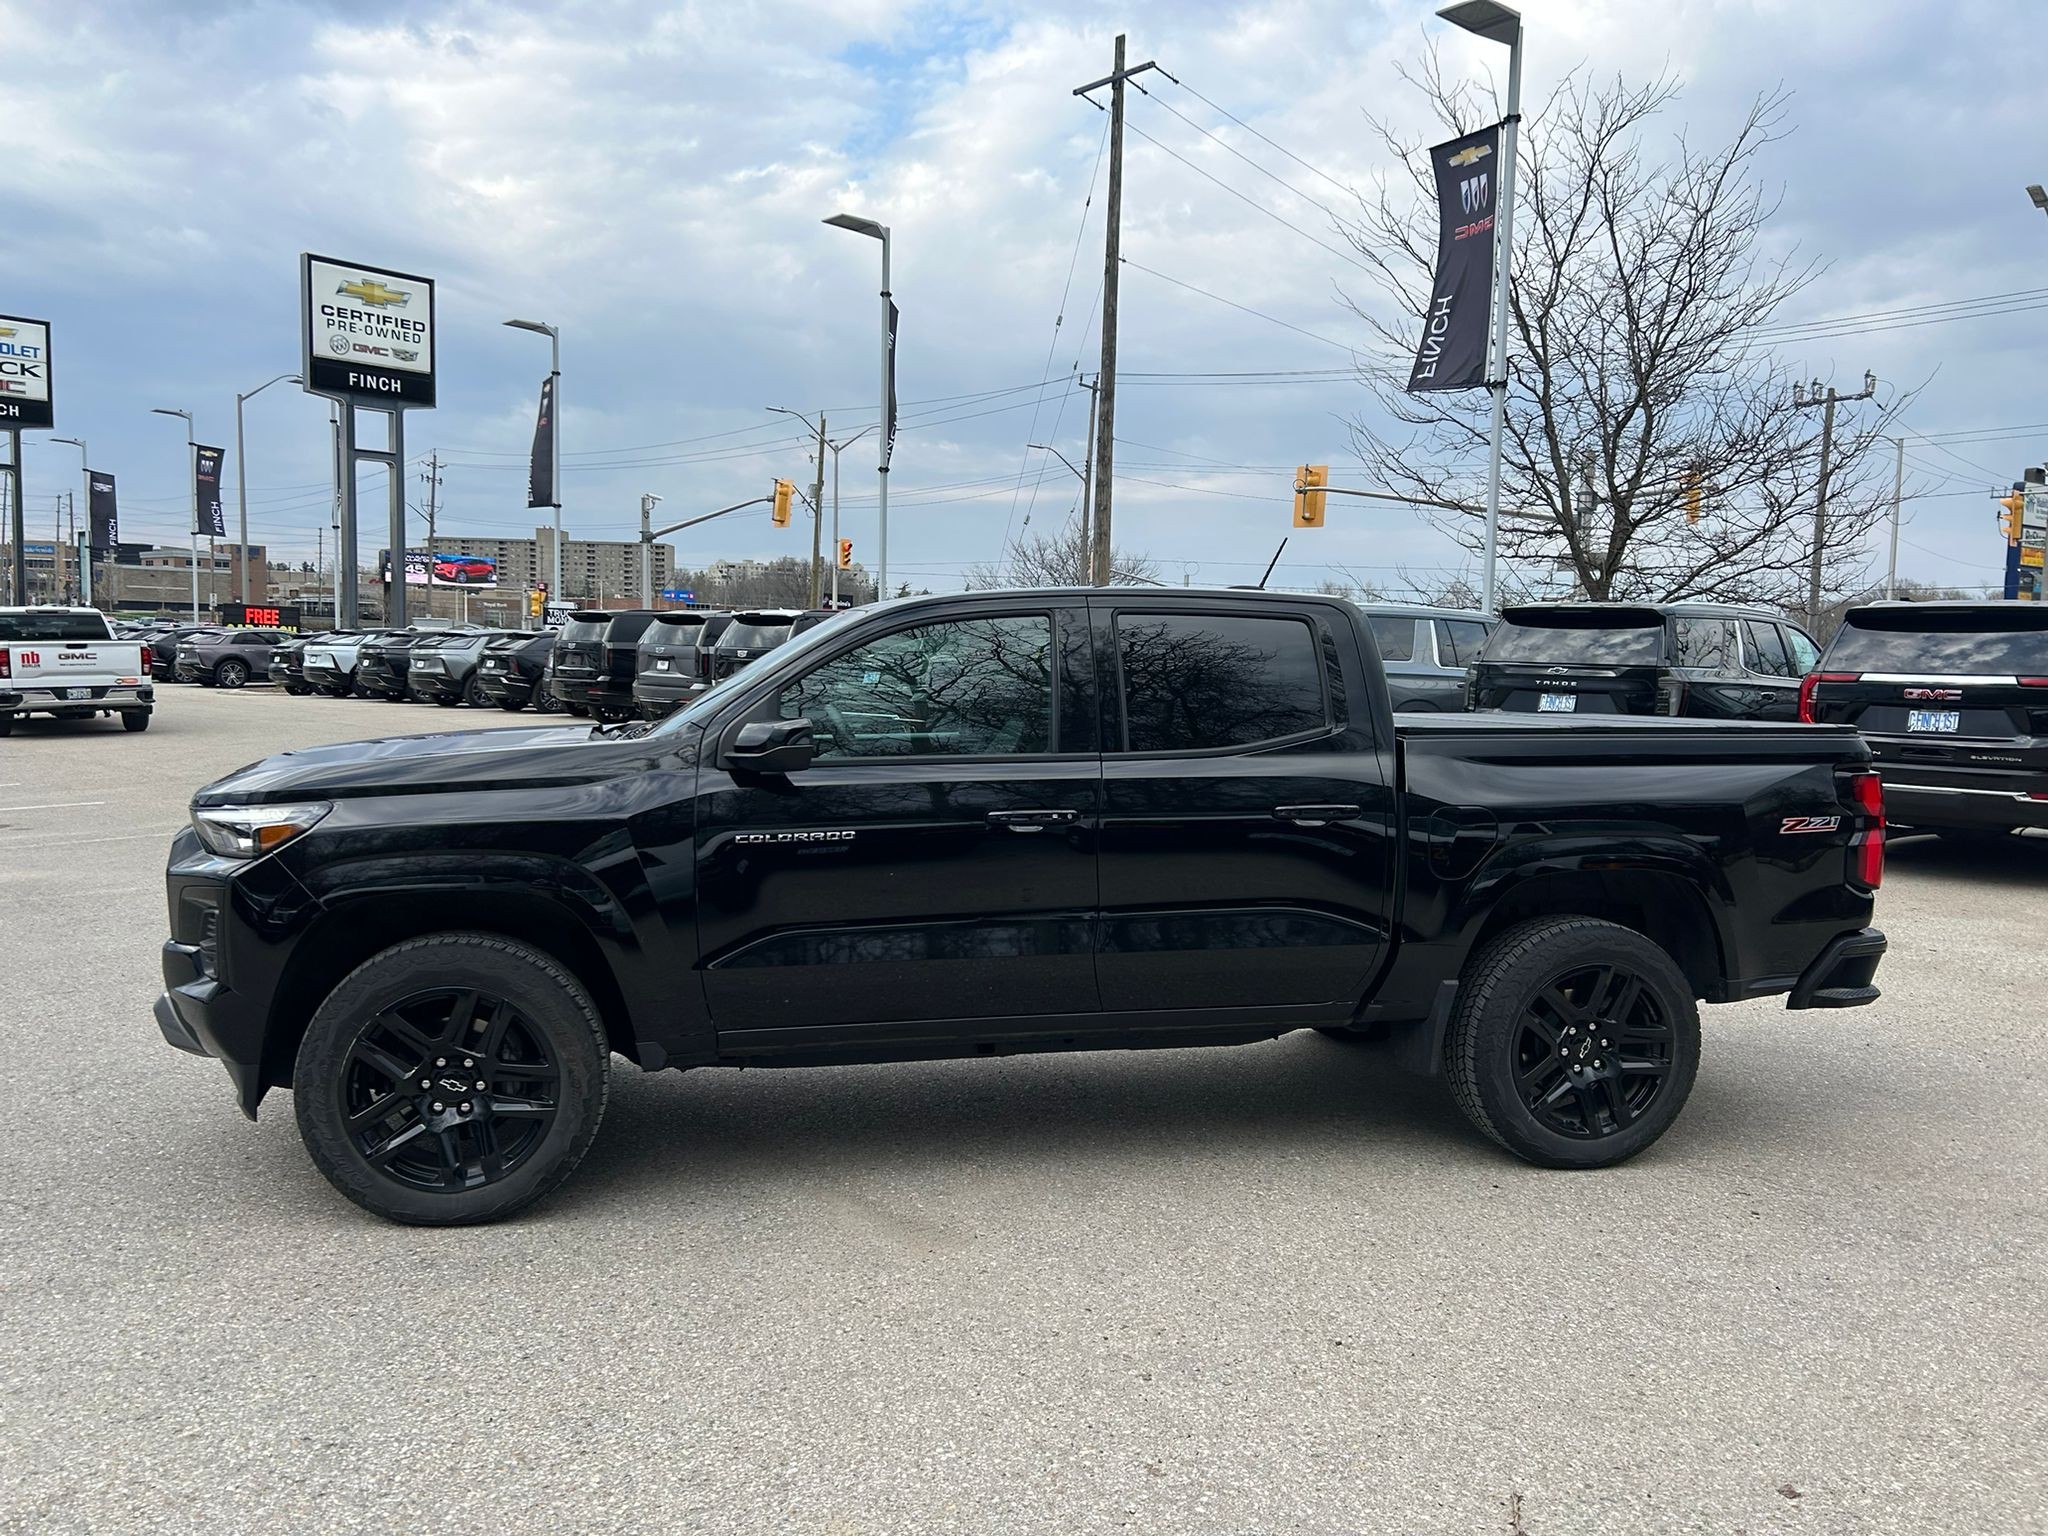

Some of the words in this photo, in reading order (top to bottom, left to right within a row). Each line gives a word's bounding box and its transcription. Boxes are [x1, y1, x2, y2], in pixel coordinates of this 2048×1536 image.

[321, 304, 425, 333] CERTIFIED
[327, 318, 421, 344] PRE-OWNED
[352, 343, 389, 357] GMC
[349, 372, 402, 393] FINCH
[211, 501, 223, 533] FINCH
[109, 518, 117, 546] FINCH
[245, 608, 280, 625] FREE
[547, 609, 576, 618] TRUC
[21, 651, 40, 664] nb
[1903, 688, 1963, 701] GMC
[1970, 754, 2023, 763] ELEVATION
[735, 831, 856, 844] COLORADO
